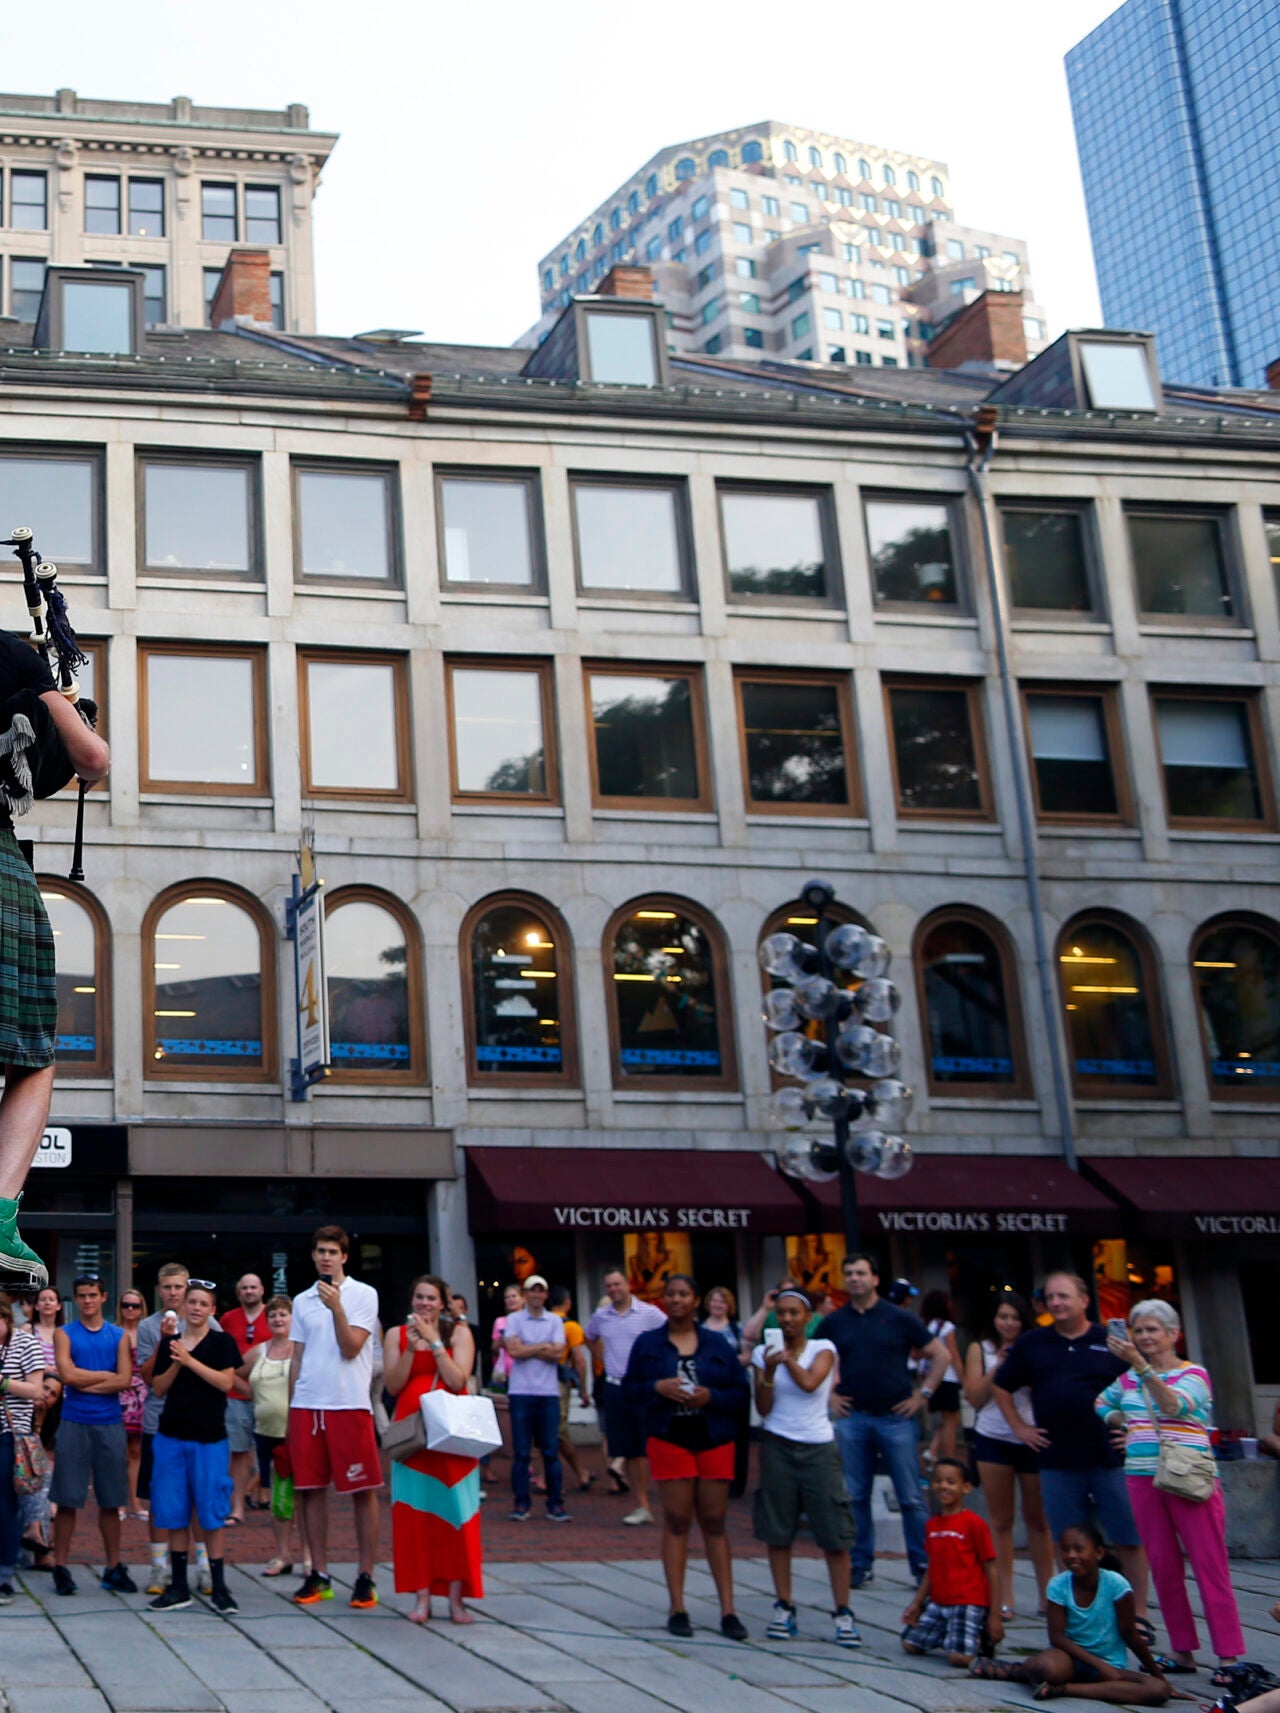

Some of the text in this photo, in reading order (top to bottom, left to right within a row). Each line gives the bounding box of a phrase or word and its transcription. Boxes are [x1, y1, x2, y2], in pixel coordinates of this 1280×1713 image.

[299, 957, 319, 1029] 4
[553, 1207, 751, 1227] VICTORIA'S SECRET
[878, 1212, 1068, 1232] VICTORIA'S SECRET
[1194, 1215, 1280, 1234] VICTORI
